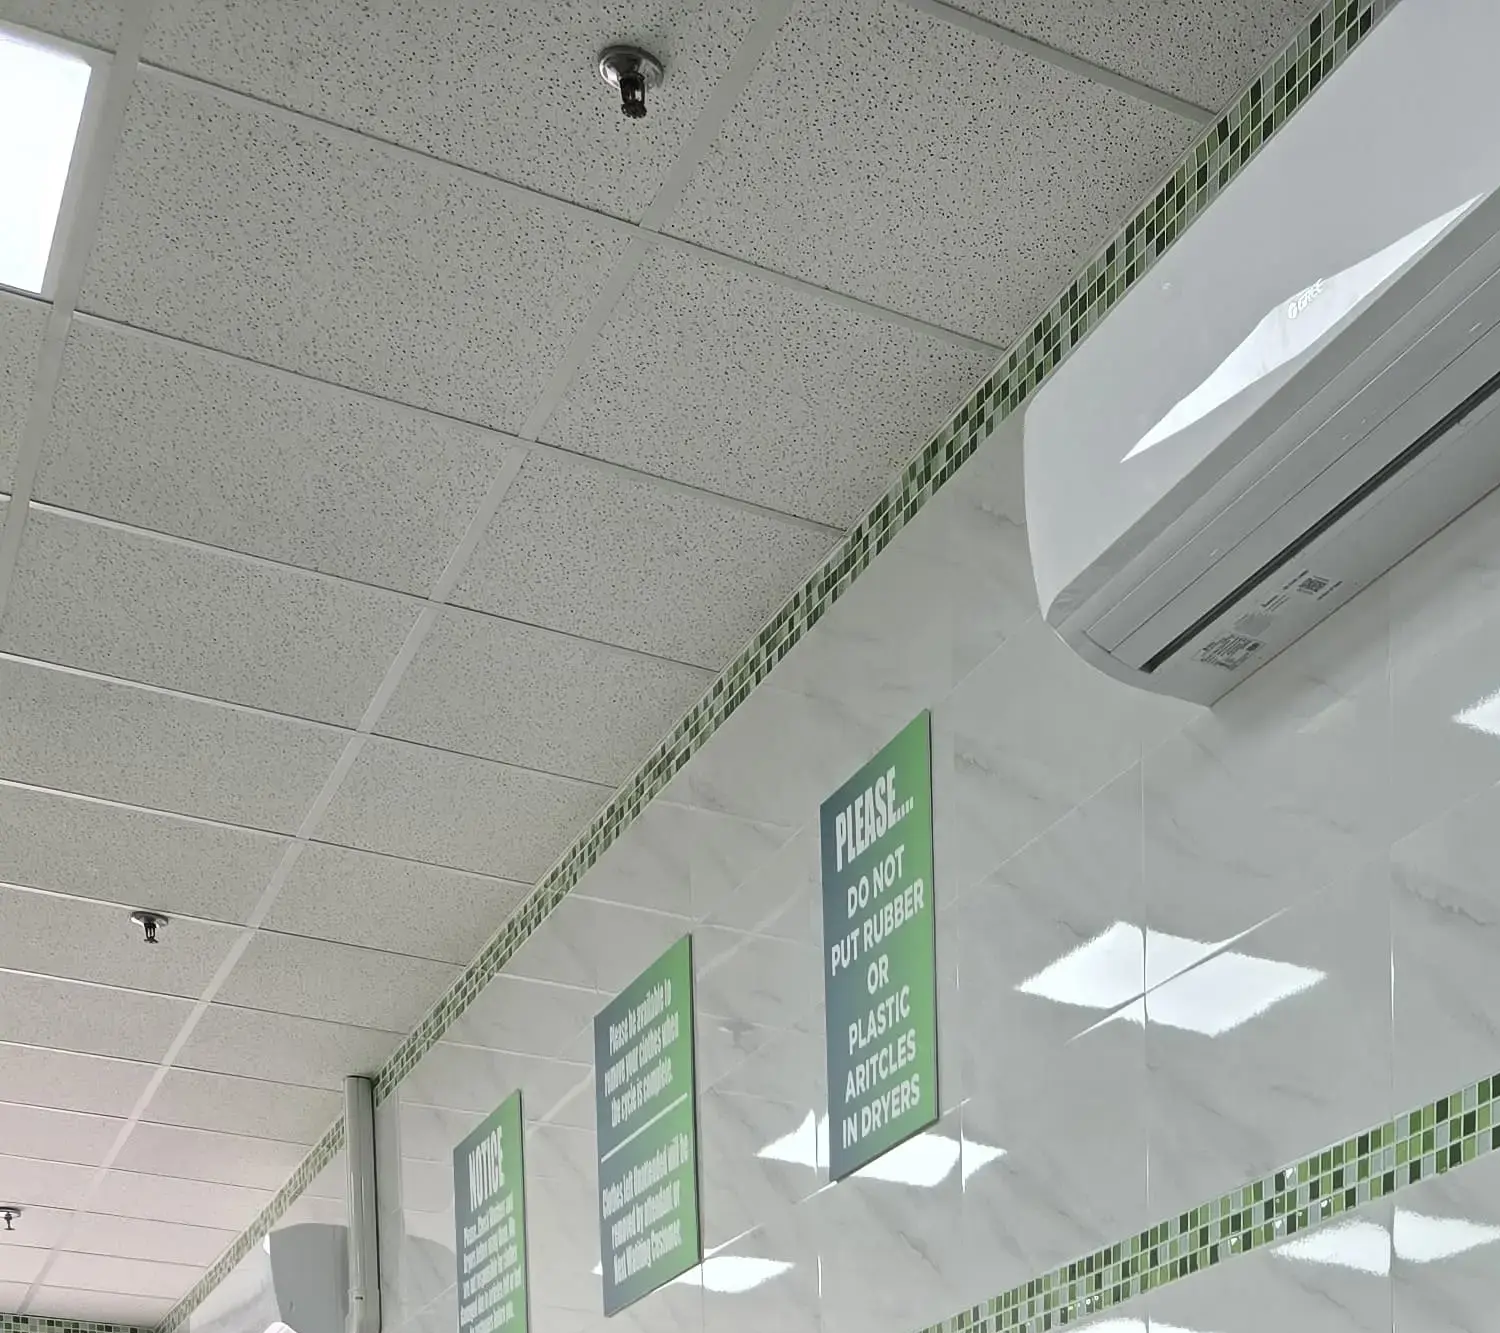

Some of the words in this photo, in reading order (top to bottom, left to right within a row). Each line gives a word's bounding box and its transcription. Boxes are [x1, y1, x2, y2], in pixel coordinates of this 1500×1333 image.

[847, 876, 869, 918] DO
[873, 844, 904, 898] NOT
[831, 927, 860, 976] PUT
[863, 877, 924, 948] RUBBER
[867, 953, 889, 995] OR
[604, 1060, 625, 1097] remove
[625, 1046, 638, 1082] your
[638, 1025, 661, 1068] clothes
[661, 1010, 679, 1049] when
[609, 1017, 628, 1056] Please
[628, 1008, 637, 1038] be
[637, 983, 663, 1031] available
[664, 978, 672, 1007] to
[848, 985, 911, 1055] PLASTIC
[845, 1028, 916, 1103] ARITCLES
[611, 1096, 621, 1128] the
[621, 1082, 637, 1121] cycle
[842, 1113, 857, 1148] IN
[862, 1073, 920, 1138] DRYERS
[469, 1125, 505, 1213] NOTICE
